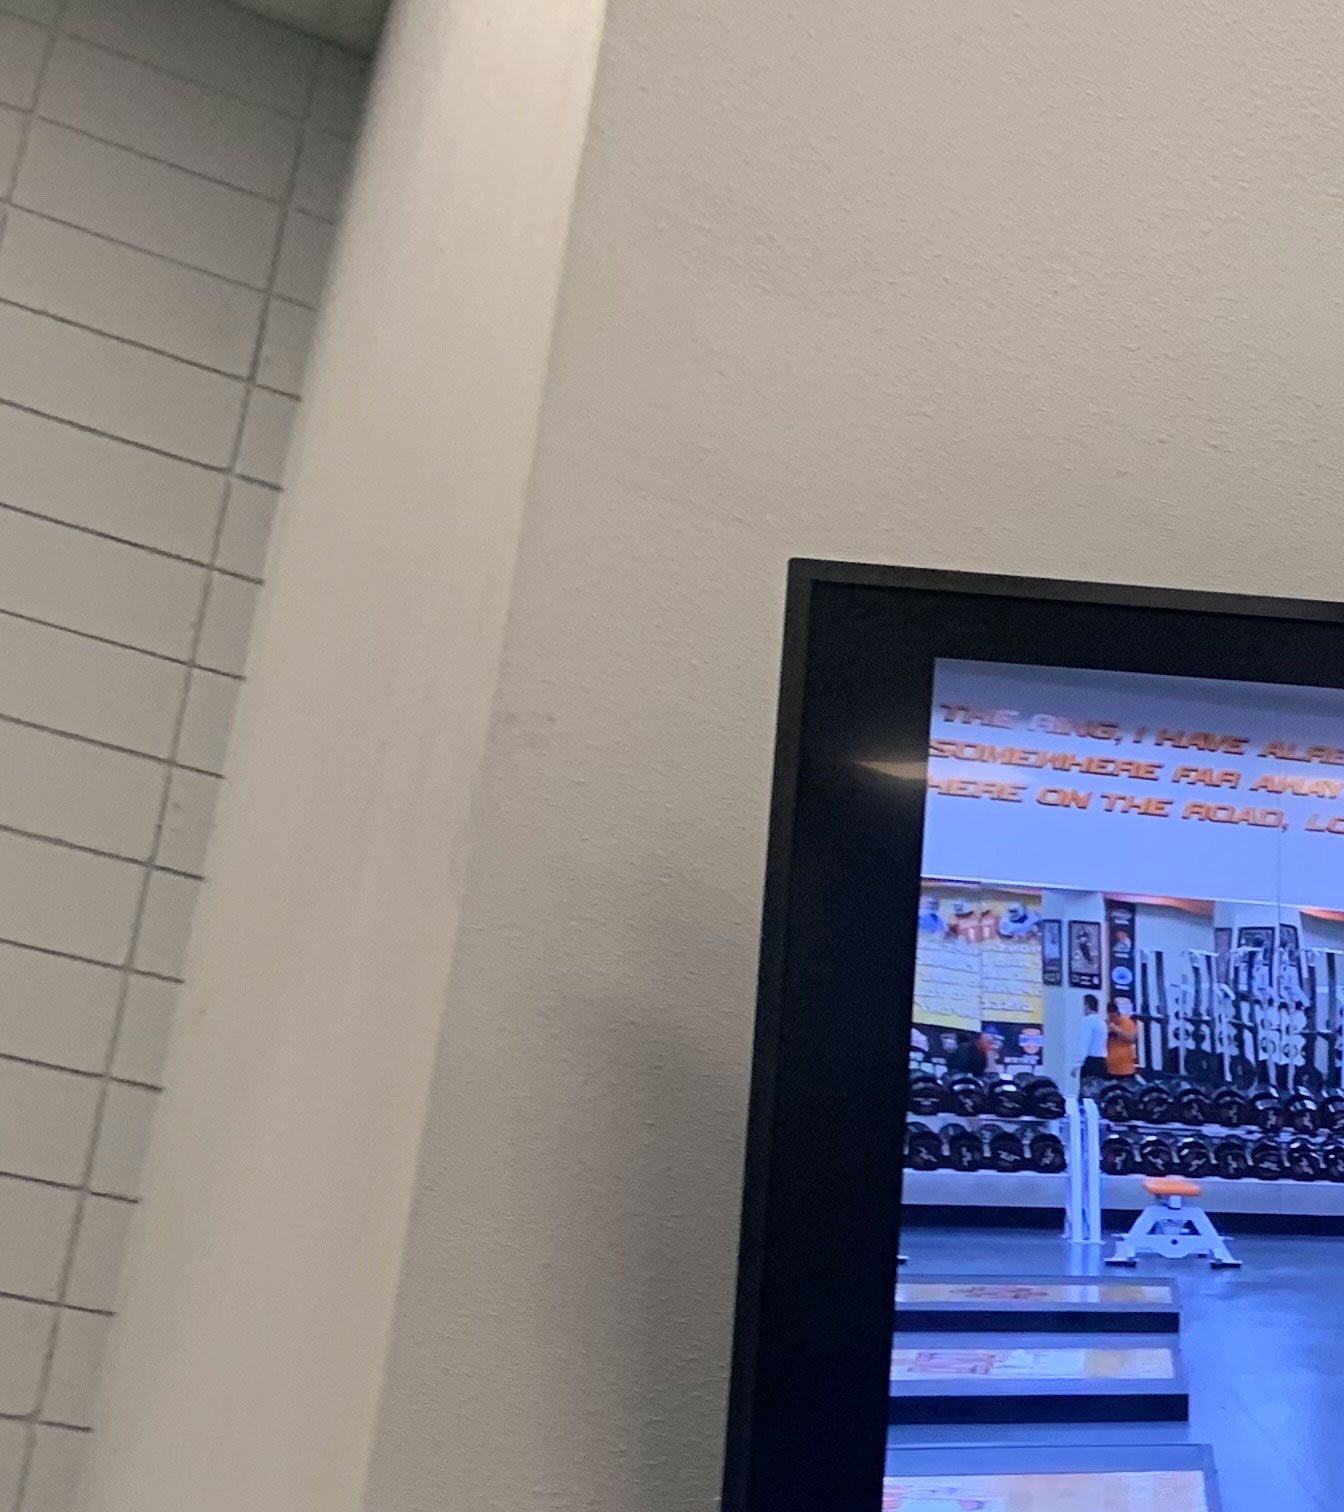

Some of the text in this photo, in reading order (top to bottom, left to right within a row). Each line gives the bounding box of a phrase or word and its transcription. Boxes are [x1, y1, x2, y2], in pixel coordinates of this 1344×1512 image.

[939, 703, 1020, 730] THE
[1154, 727, 1249, 756] HAVE
[928, 737, 1165, 782] SOMEWHERE
[1171, 764, 1242, 791] FAR
[1035, 786, 1093, 810] ON
[1100, 791, 1174, 818] THE
[1180, 801, 1289, 834] ROAD,
